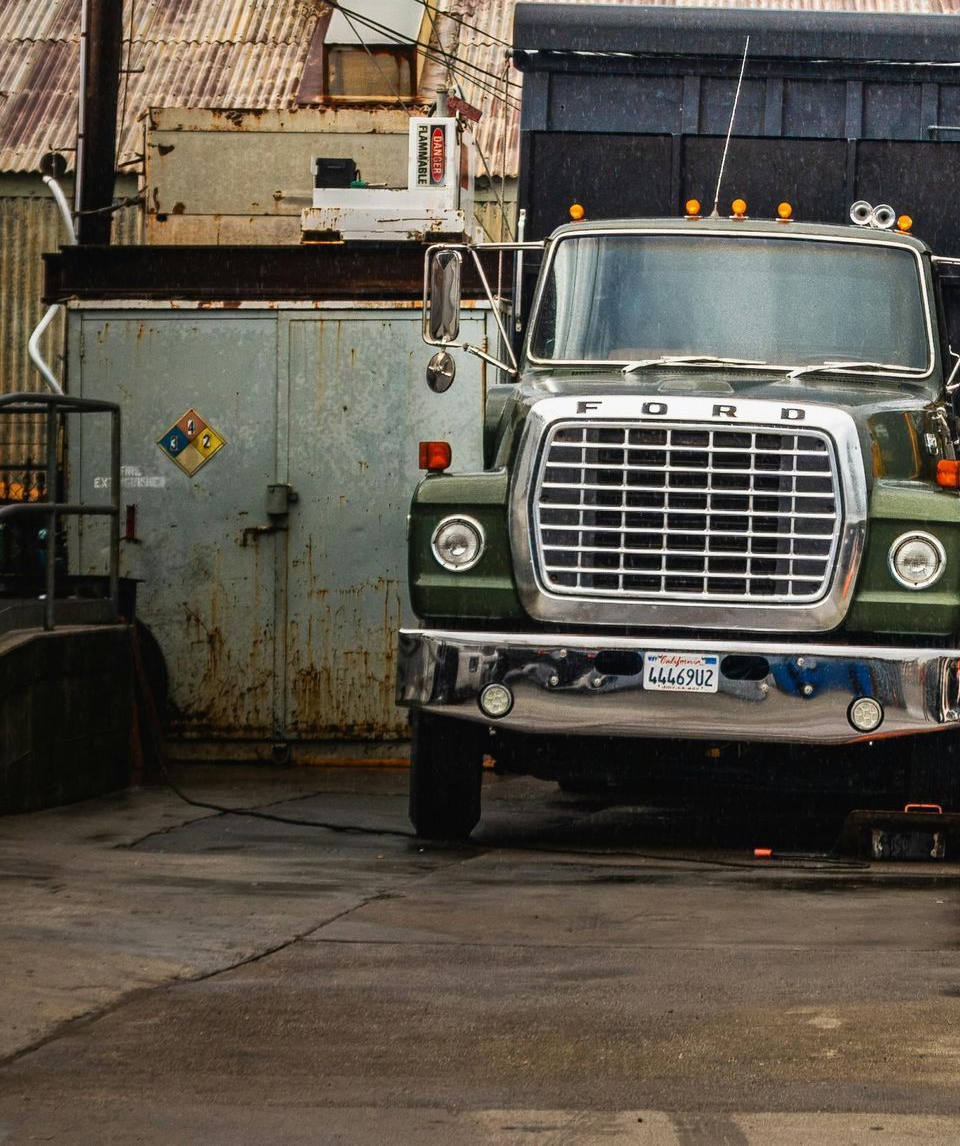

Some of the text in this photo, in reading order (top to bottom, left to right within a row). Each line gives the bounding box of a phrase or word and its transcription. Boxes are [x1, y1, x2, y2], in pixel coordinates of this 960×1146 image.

[418, 125, 428, 184] FLAMMABLE
[432, 135, 443, 174] DANGER
[576, 401, 806, 421] FORD
[187, 419, 195, 435] 4
[203, 434, 211, 449] 2
[659, 655, 701, 667] California
[648, 666, 714, 687] 44469U2
